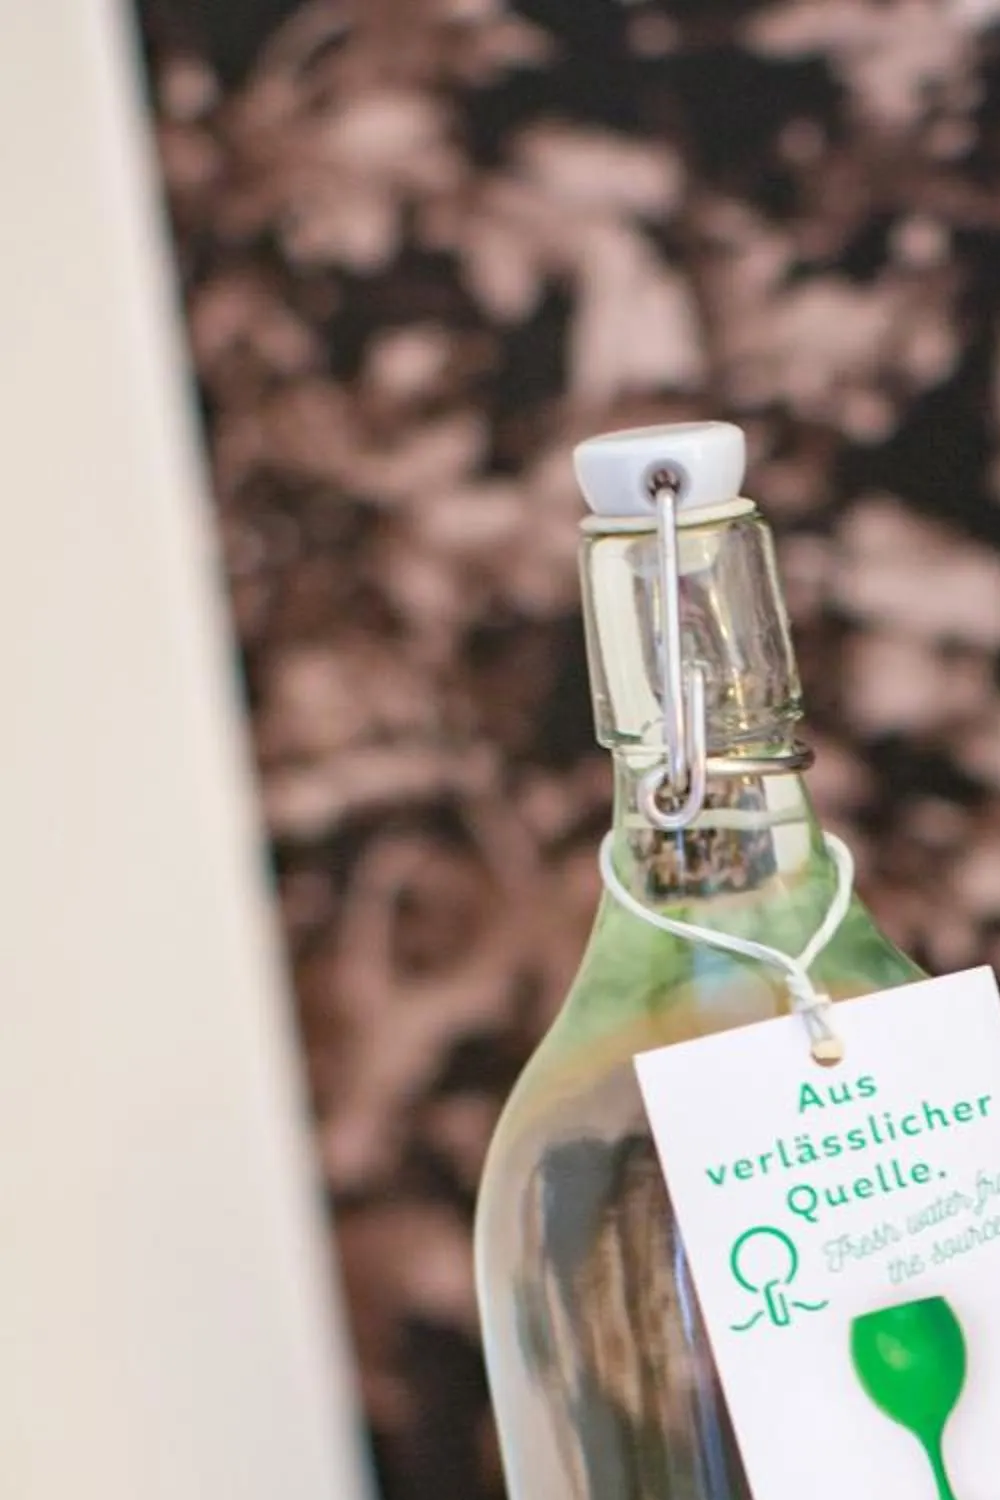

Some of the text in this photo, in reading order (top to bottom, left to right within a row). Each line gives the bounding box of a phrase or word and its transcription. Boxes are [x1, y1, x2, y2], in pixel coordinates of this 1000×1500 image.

[797, 1075, 878, 1114] Aus
[705, 1093, 992, 1186] verlässlicher
[785, 1159, 947, 1223] Quelle.
[822, 1219, 903, 1273] Fresh
[906, 1189, 973, 1236] water
[886, 1250, 926, 1285] the
